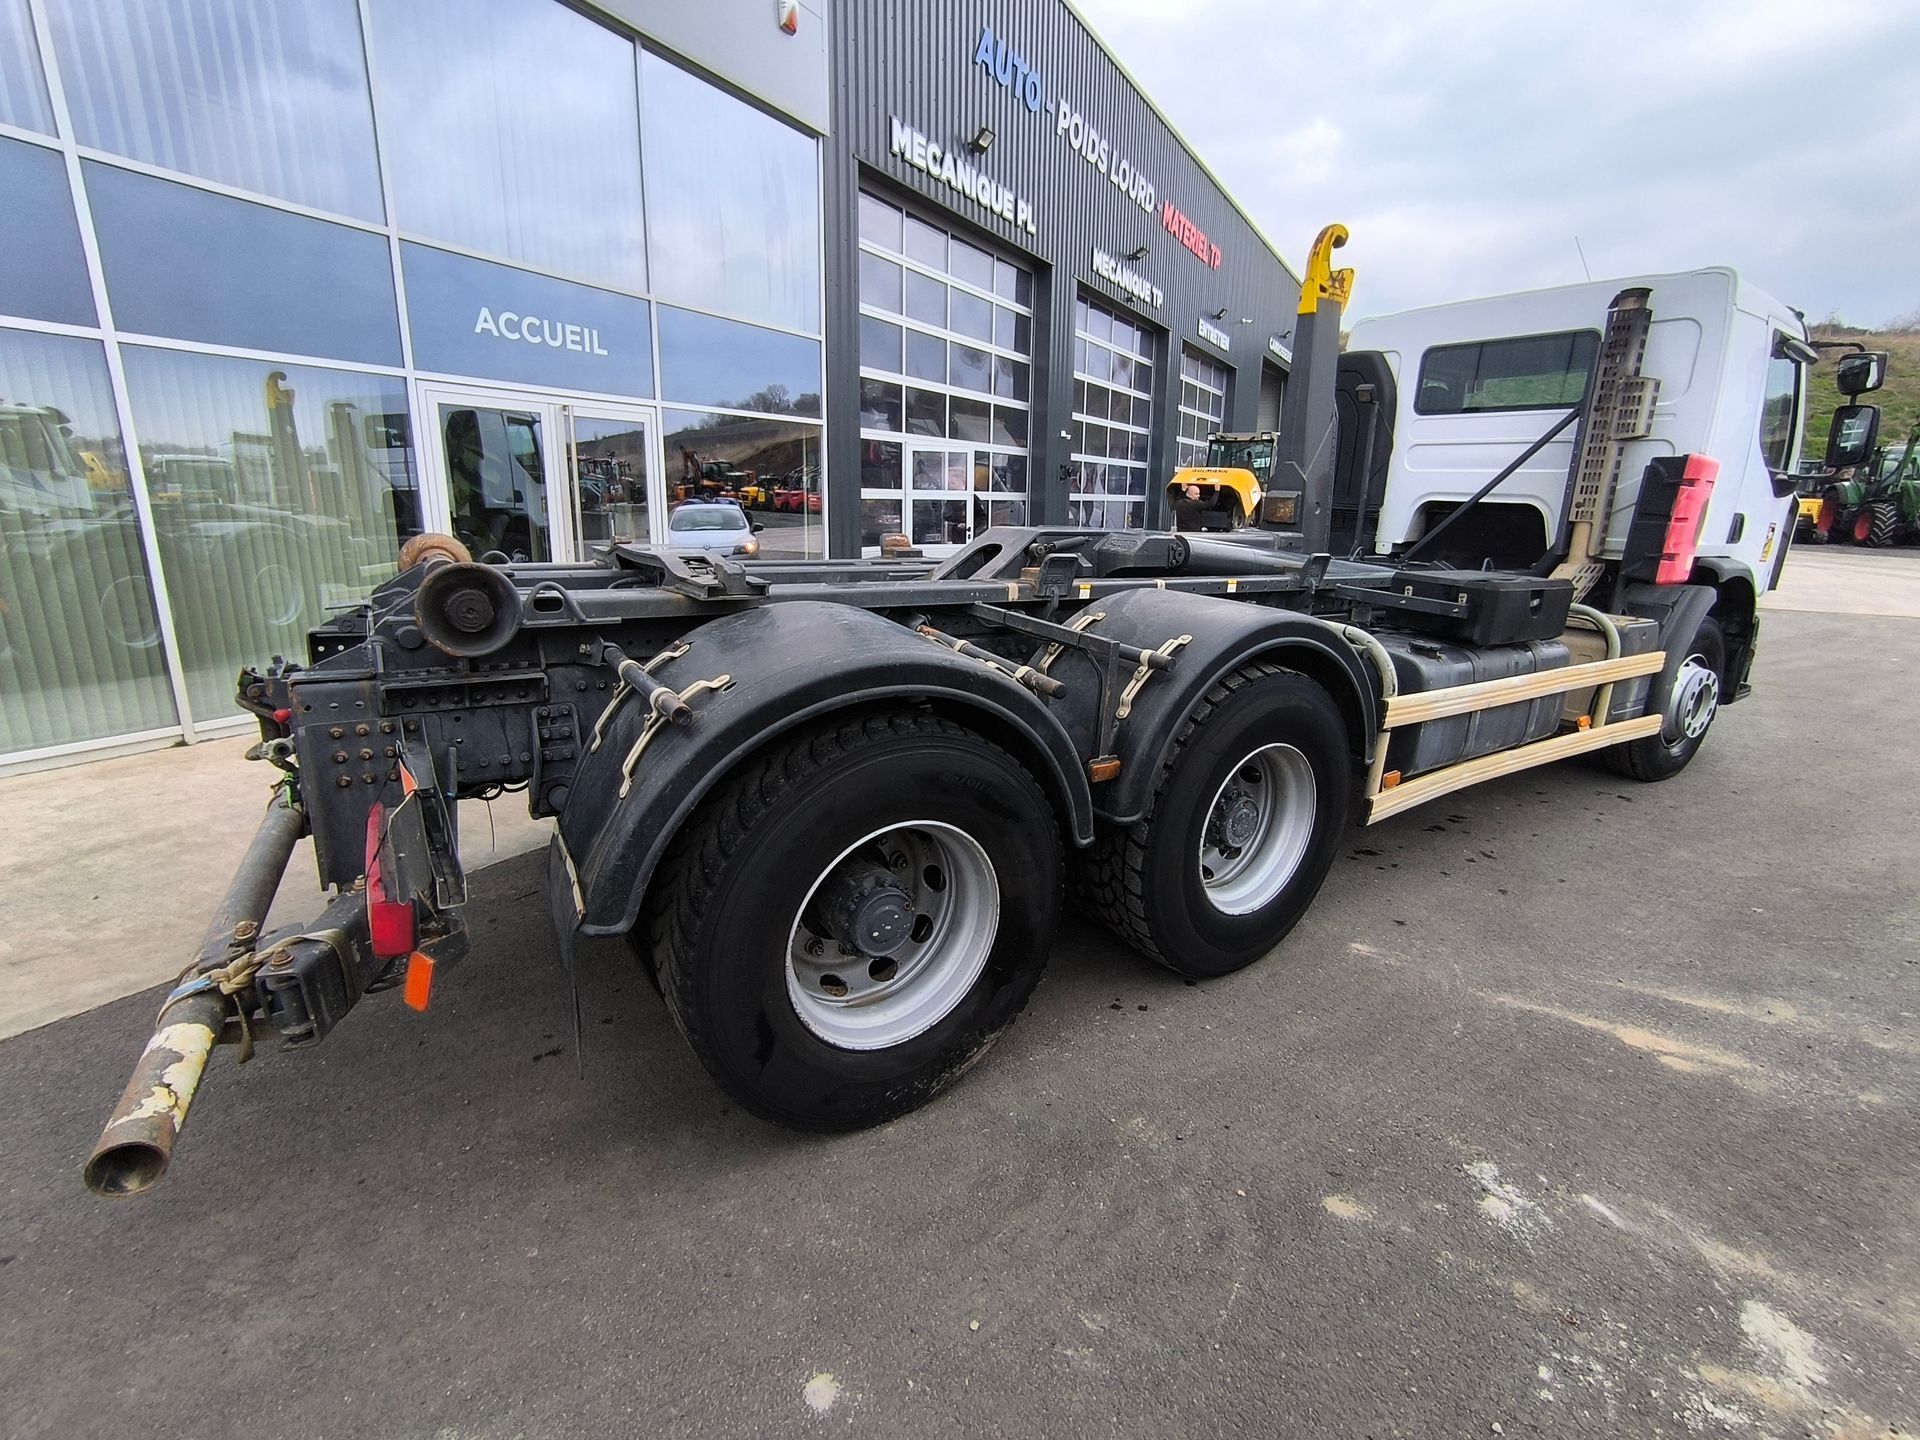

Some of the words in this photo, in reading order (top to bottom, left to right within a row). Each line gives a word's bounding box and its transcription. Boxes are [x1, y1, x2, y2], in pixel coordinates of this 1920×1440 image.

[890, 116, 1014, 223] MECANIQUE
[1017, 198, 1037, 236] PL
[974, 27, 1042, 112] AUTO
[1057, 99, 1109, 174] POIDS
[1110, 150, 1155, 214] LOURD
[1162, 200, 1209, 264] MATERIEL
[1209, 243, 1222, 271] TP
[1092, 247, 1152, 305] MECANIQUE
[1151, 285, 1164, 310] TP
[474, 306, 609, 356] ACCUEIL
